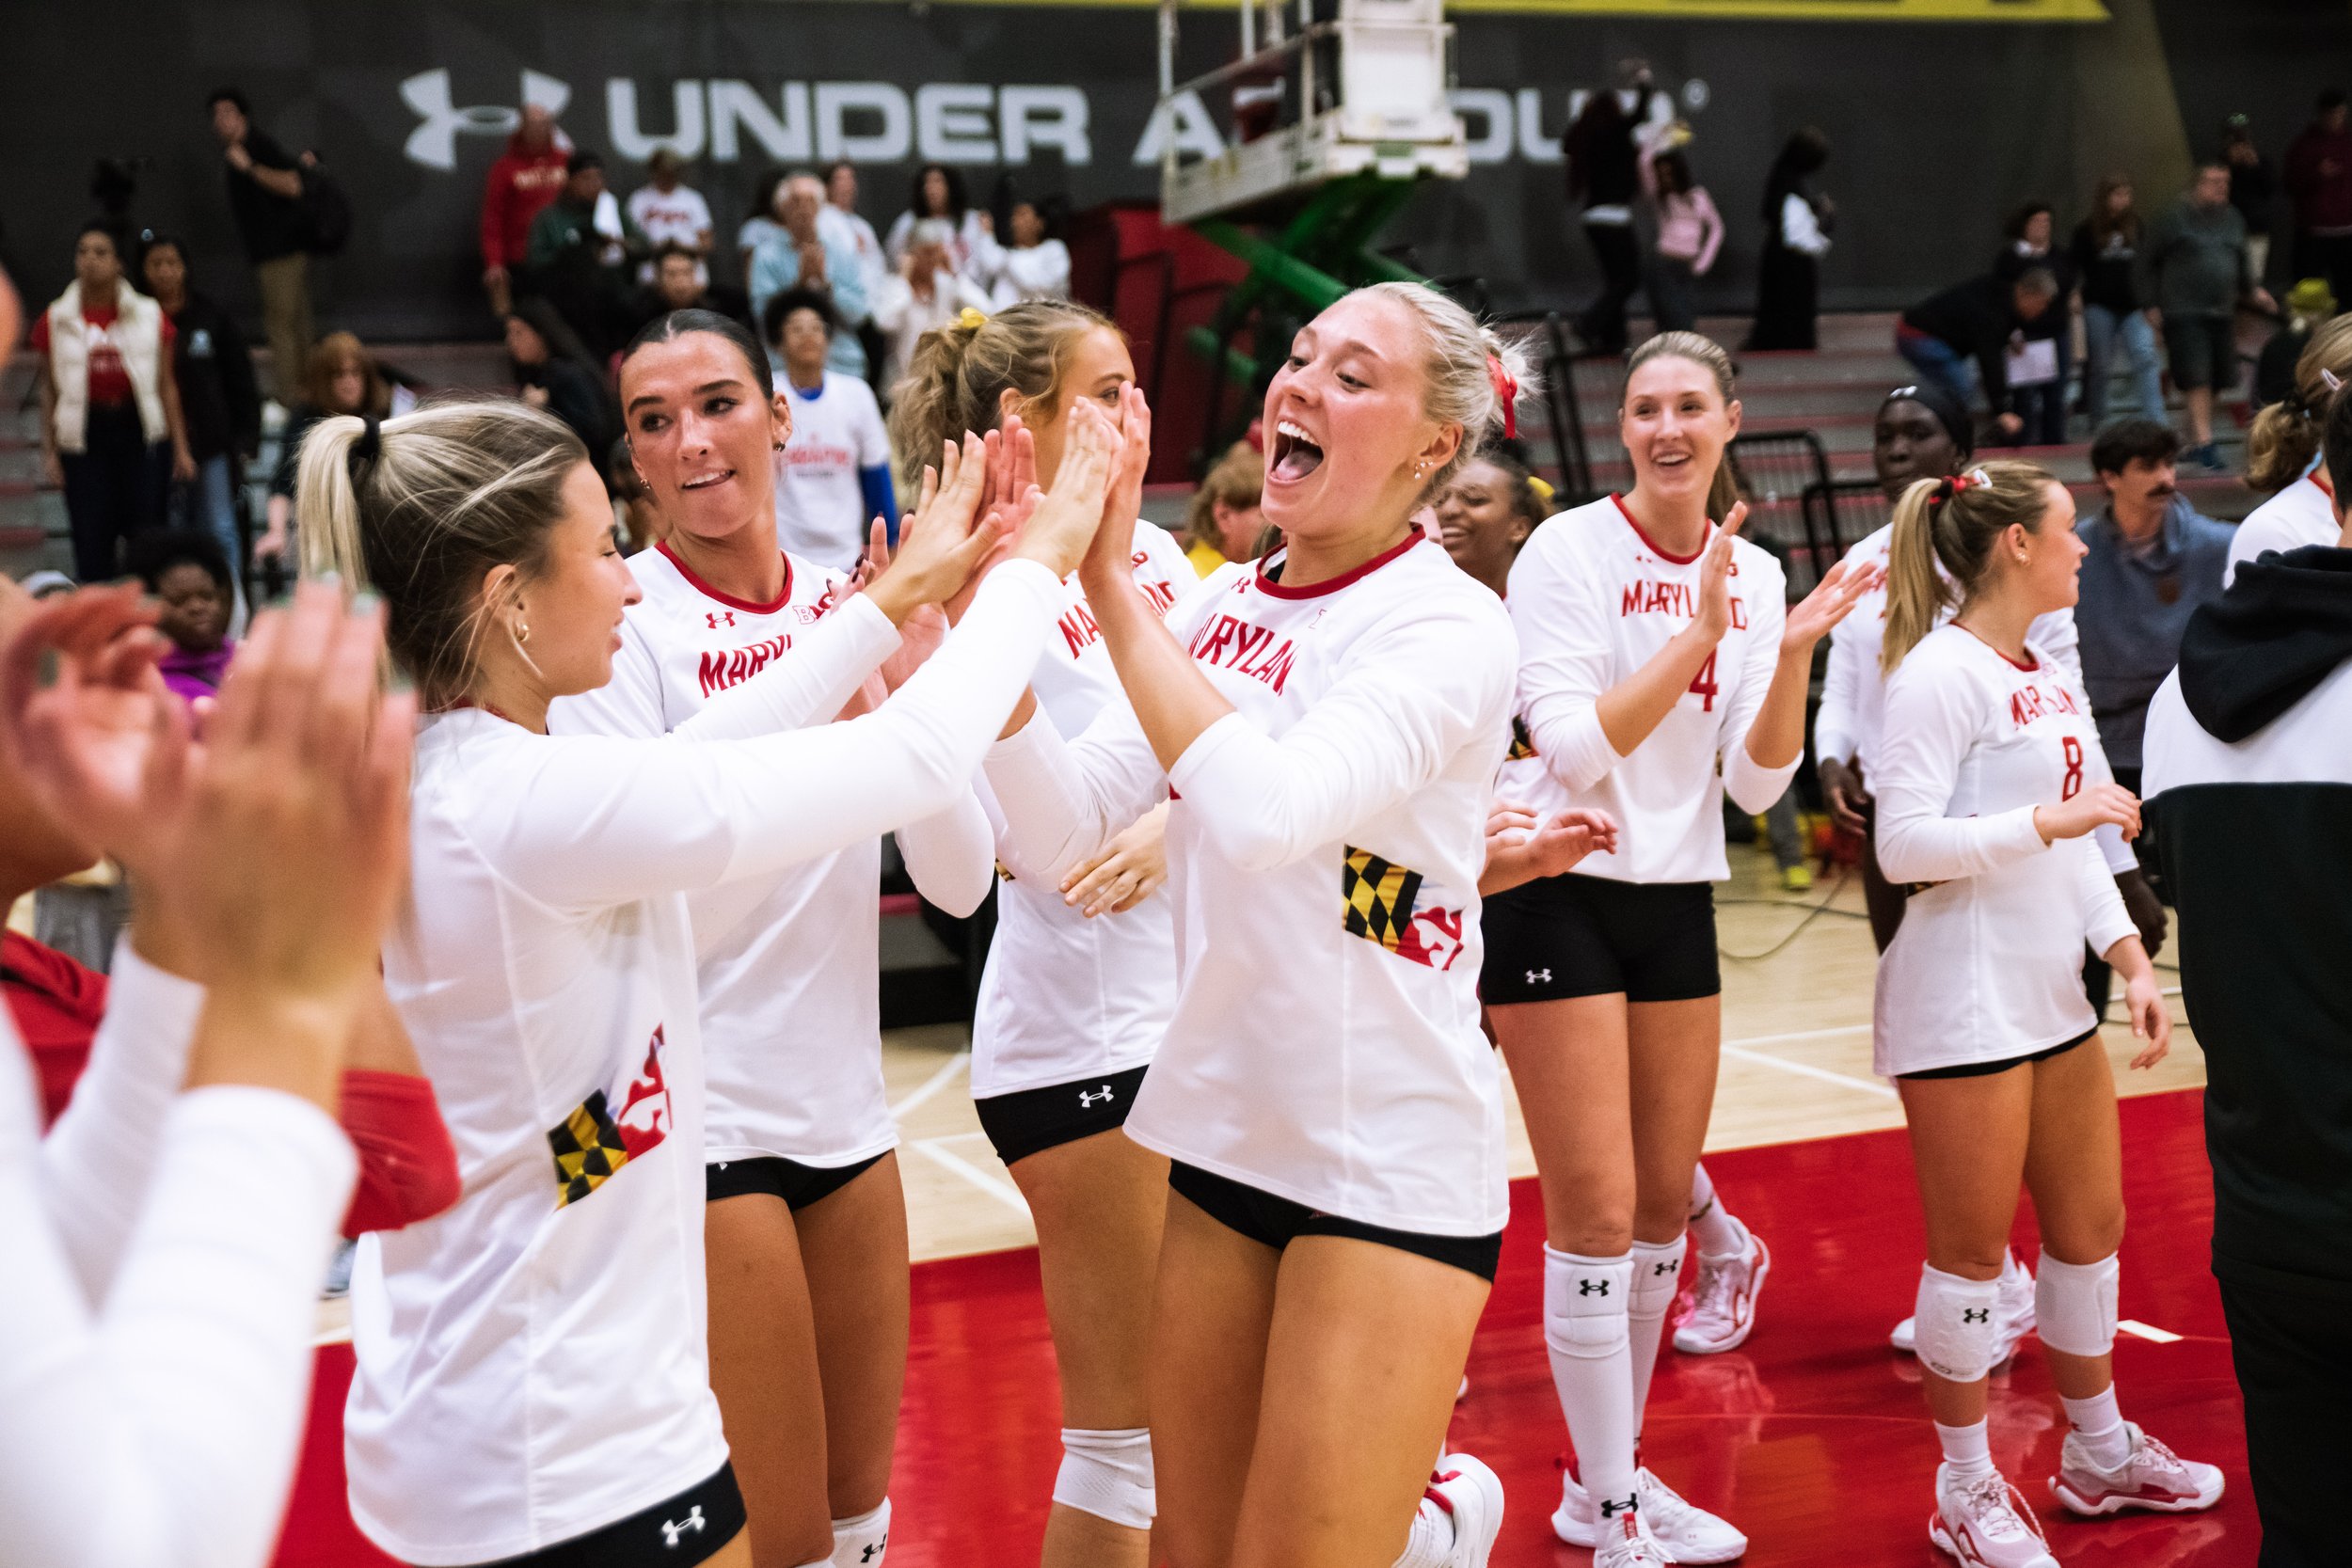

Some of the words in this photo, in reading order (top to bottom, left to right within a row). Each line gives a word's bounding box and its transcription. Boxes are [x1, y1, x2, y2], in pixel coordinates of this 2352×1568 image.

[606, 77, 1090, 165] UNDER
[1621, 579, 1748, 631] MARYLD
[2062, 736, 2084, 802] 8
